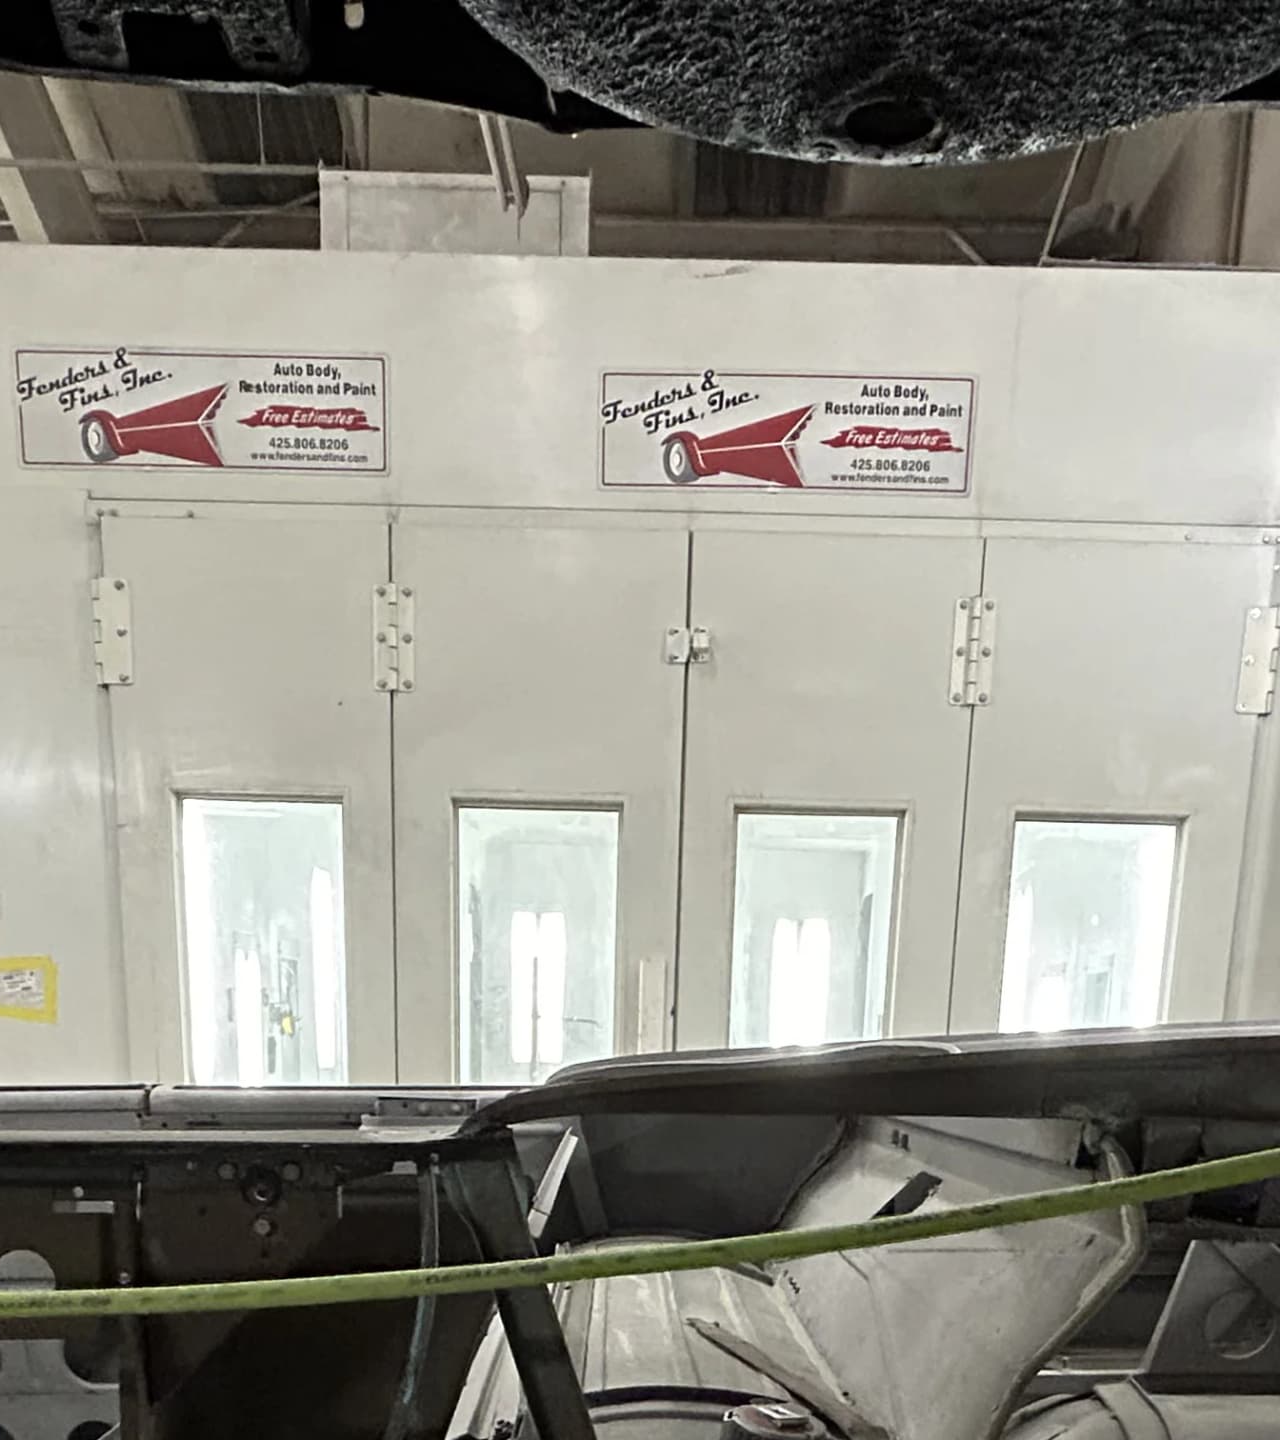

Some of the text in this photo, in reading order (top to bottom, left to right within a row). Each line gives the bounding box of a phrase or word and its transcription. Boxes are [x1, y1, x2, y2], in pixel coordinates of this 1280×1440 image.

[17, 347, 132, 401] Fenders &
[274, 363, 341, 379] Auto Body,
[59, 368, 173, 412] Fins, Inc.
[239, 380, 376, 397] Restoration and Paint
[861, 384, 929, 400] Auto Body,
[601, 370, 719, 424] Fenders &
[262, 410, 356, 426] Free Estimates
[644, 389, 760, 434] Fins, Inc.
[825, 402, 963, 418] Restoration and Paint
[269, 438, 349, 451] 425.806.8206
[845, 430, 940, 446] Free Estimates
[251, 451, 368, 464] www.fendersandfins.com
[850, 459, 931, 473] 425.806.8206
[831, 472, 949, 485] www.fendersandfins.com
